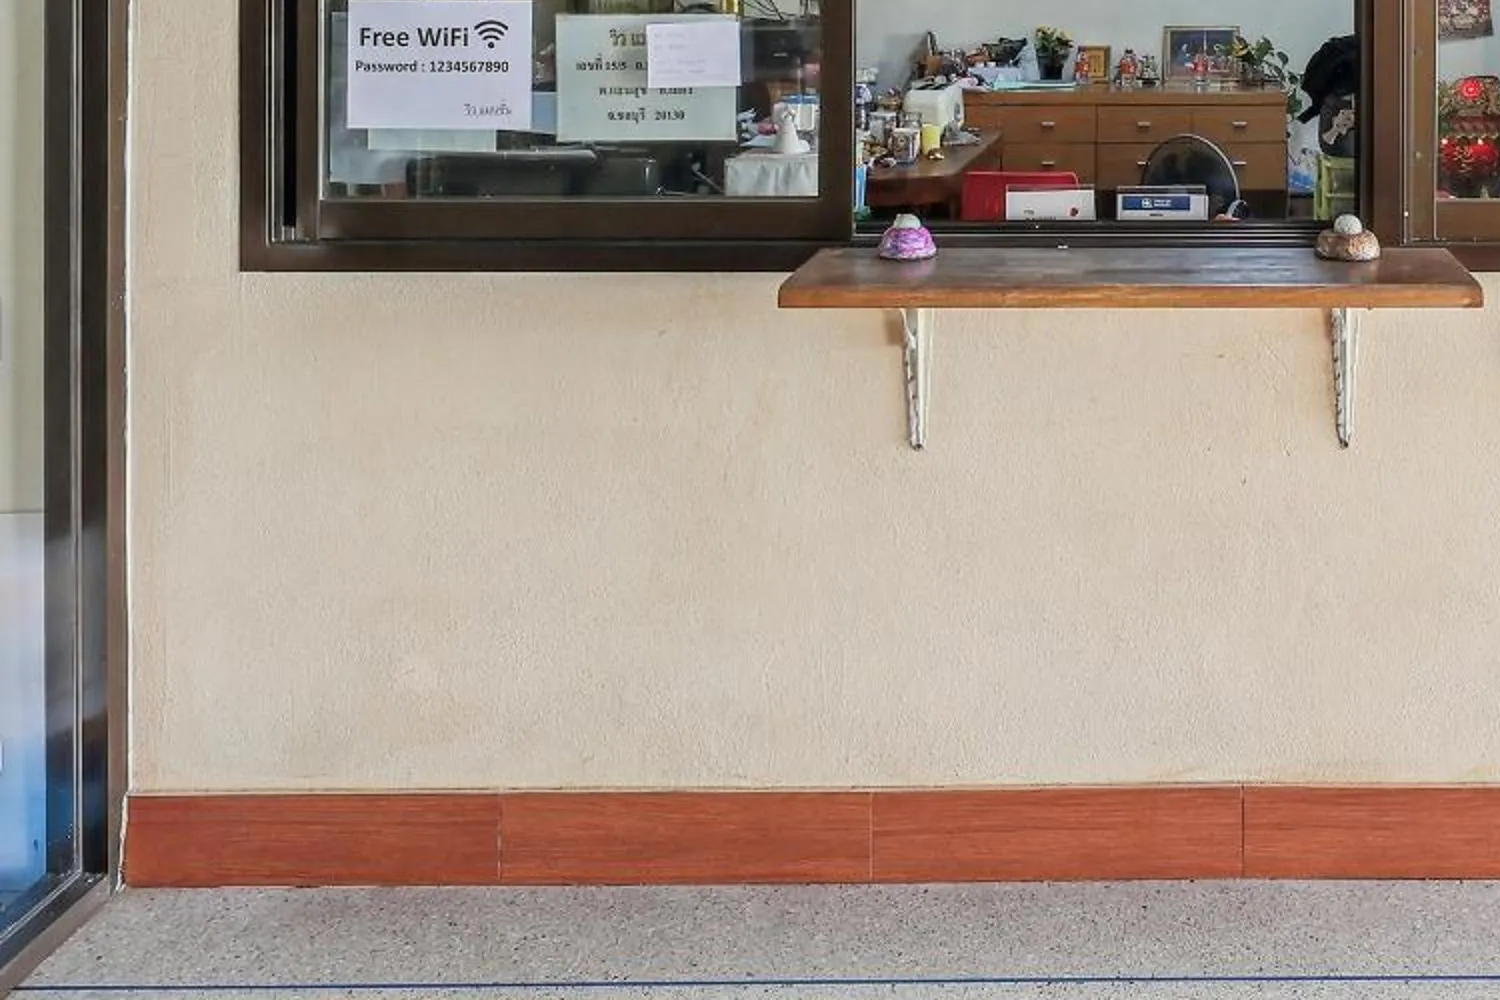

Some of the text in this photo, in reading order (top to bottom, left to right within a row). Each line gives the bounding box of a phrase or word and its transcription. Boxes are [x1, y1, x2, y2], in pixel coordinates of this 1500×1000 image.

[360, 26, 469, 47] Free WiFi
[355, 60, 418, 73] Password
[430, 60, 509, 73] 1234567890
